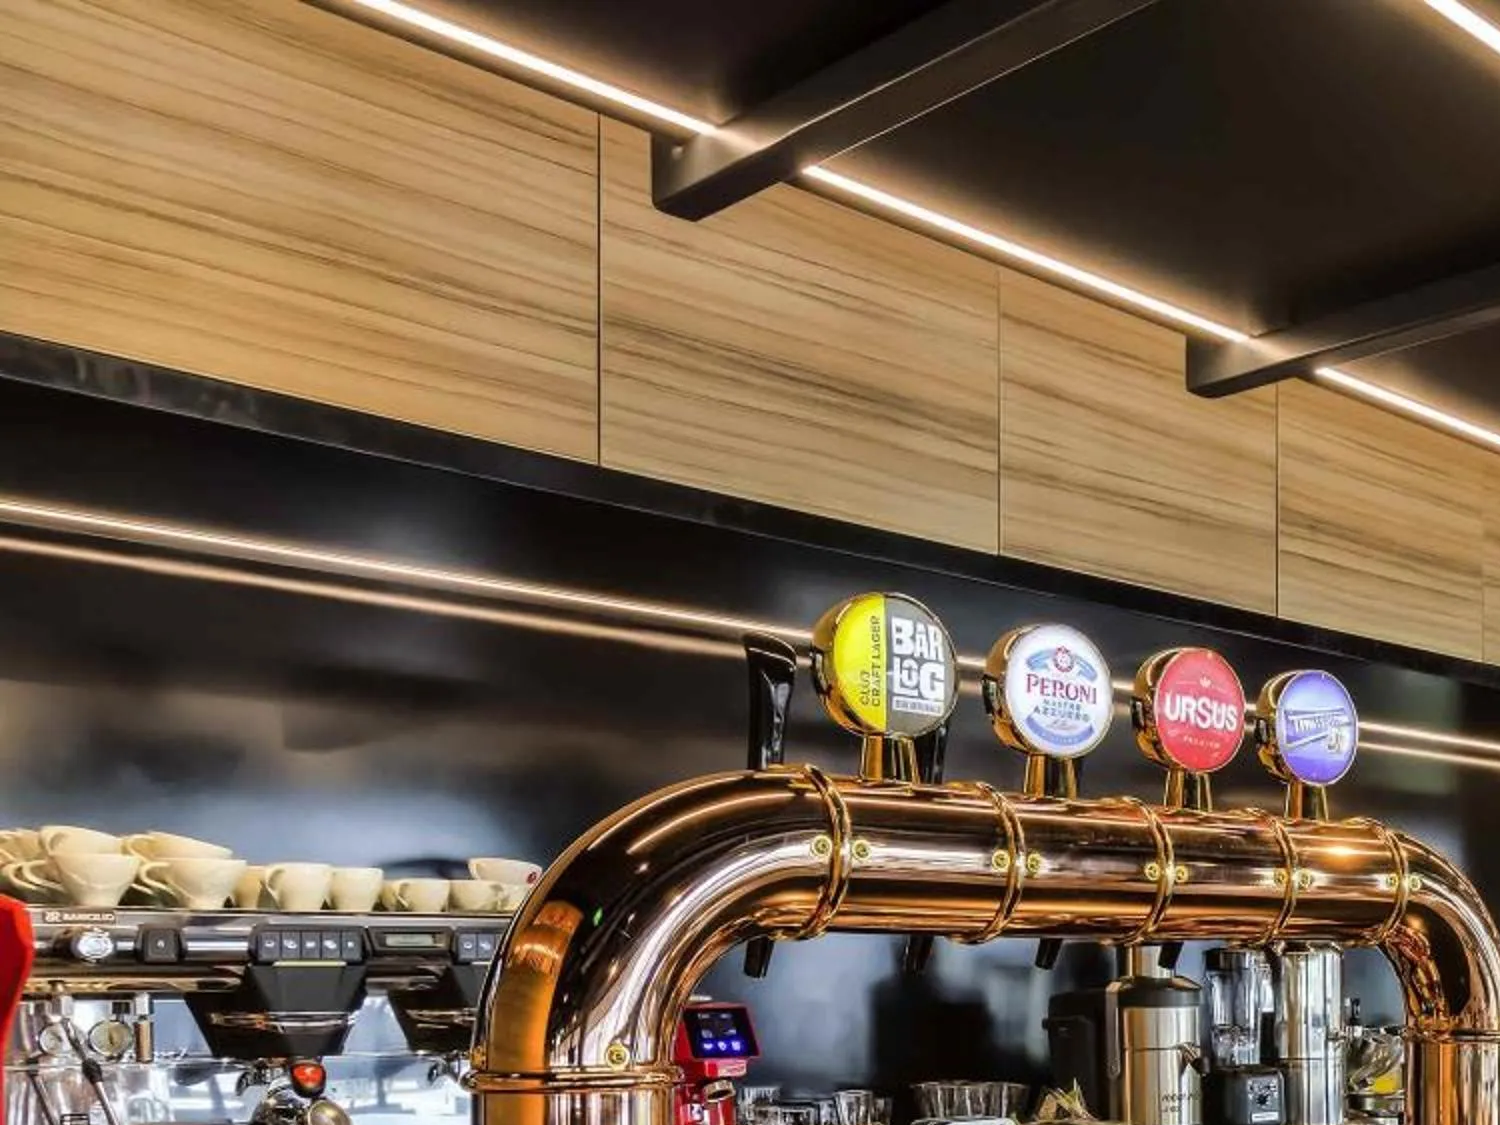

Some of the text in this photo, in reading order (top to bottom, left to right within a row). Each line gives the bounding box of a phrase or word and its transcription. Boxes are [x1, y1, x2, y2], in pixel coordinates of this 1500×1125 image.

[871, 615, 881, 707] CRAFT LAGER
[1026, 673, 1097, 705] PERONI
[1164, 690, 1238, 732] URSUS
